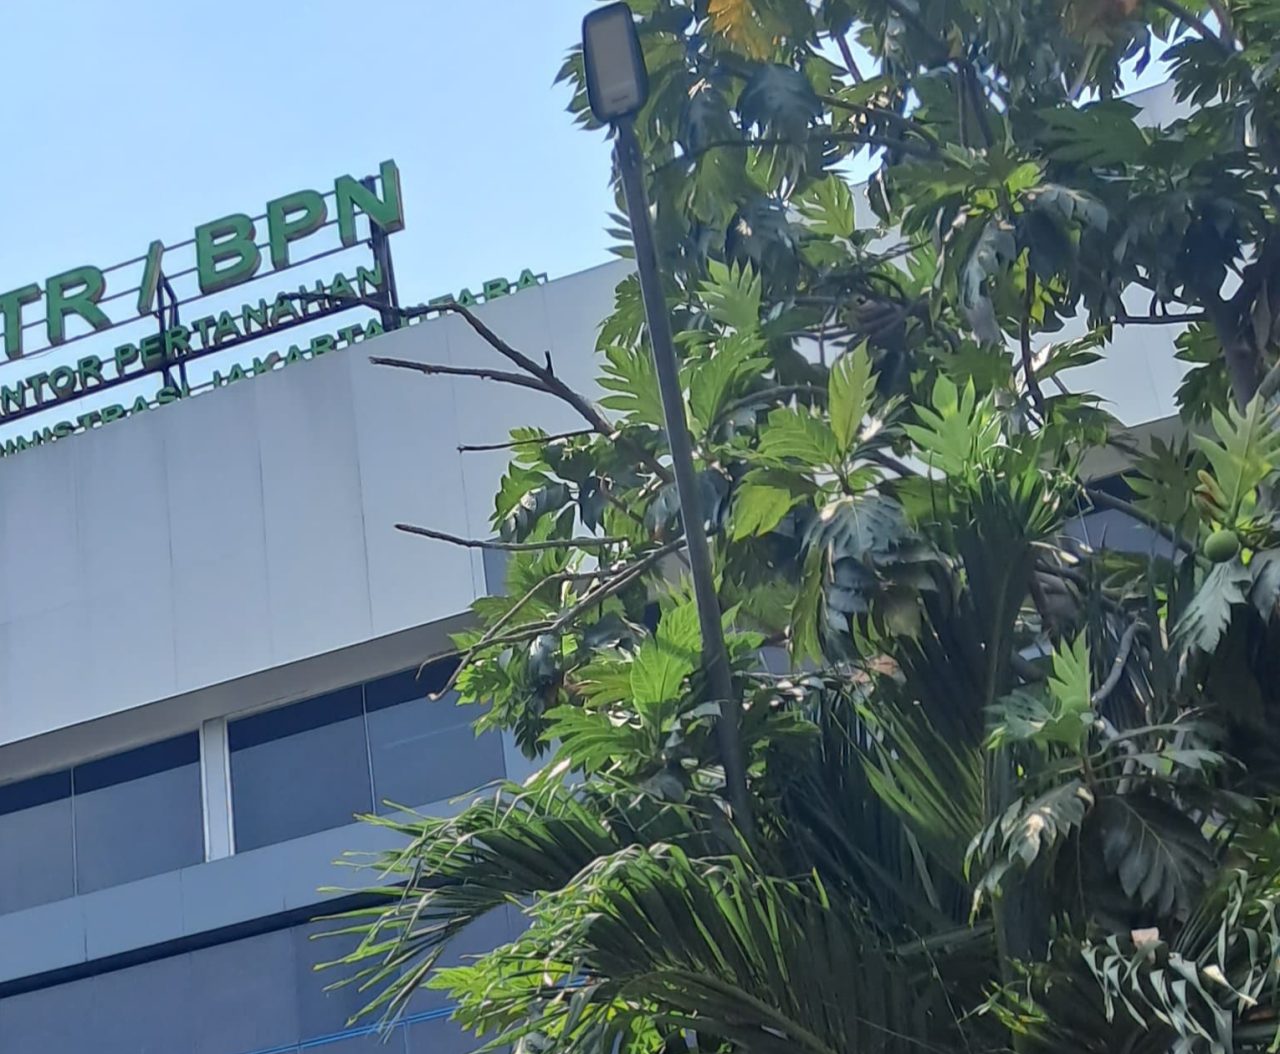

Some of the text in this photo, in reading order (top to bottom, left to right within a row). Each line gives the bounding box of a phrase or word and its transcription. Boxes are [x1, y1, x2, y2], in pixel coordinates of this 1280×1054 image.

[137, 239, 165, 316] /
[195, 158, 406, 296] BPN
[114, 259, 383, 379] PERTANAHAN
